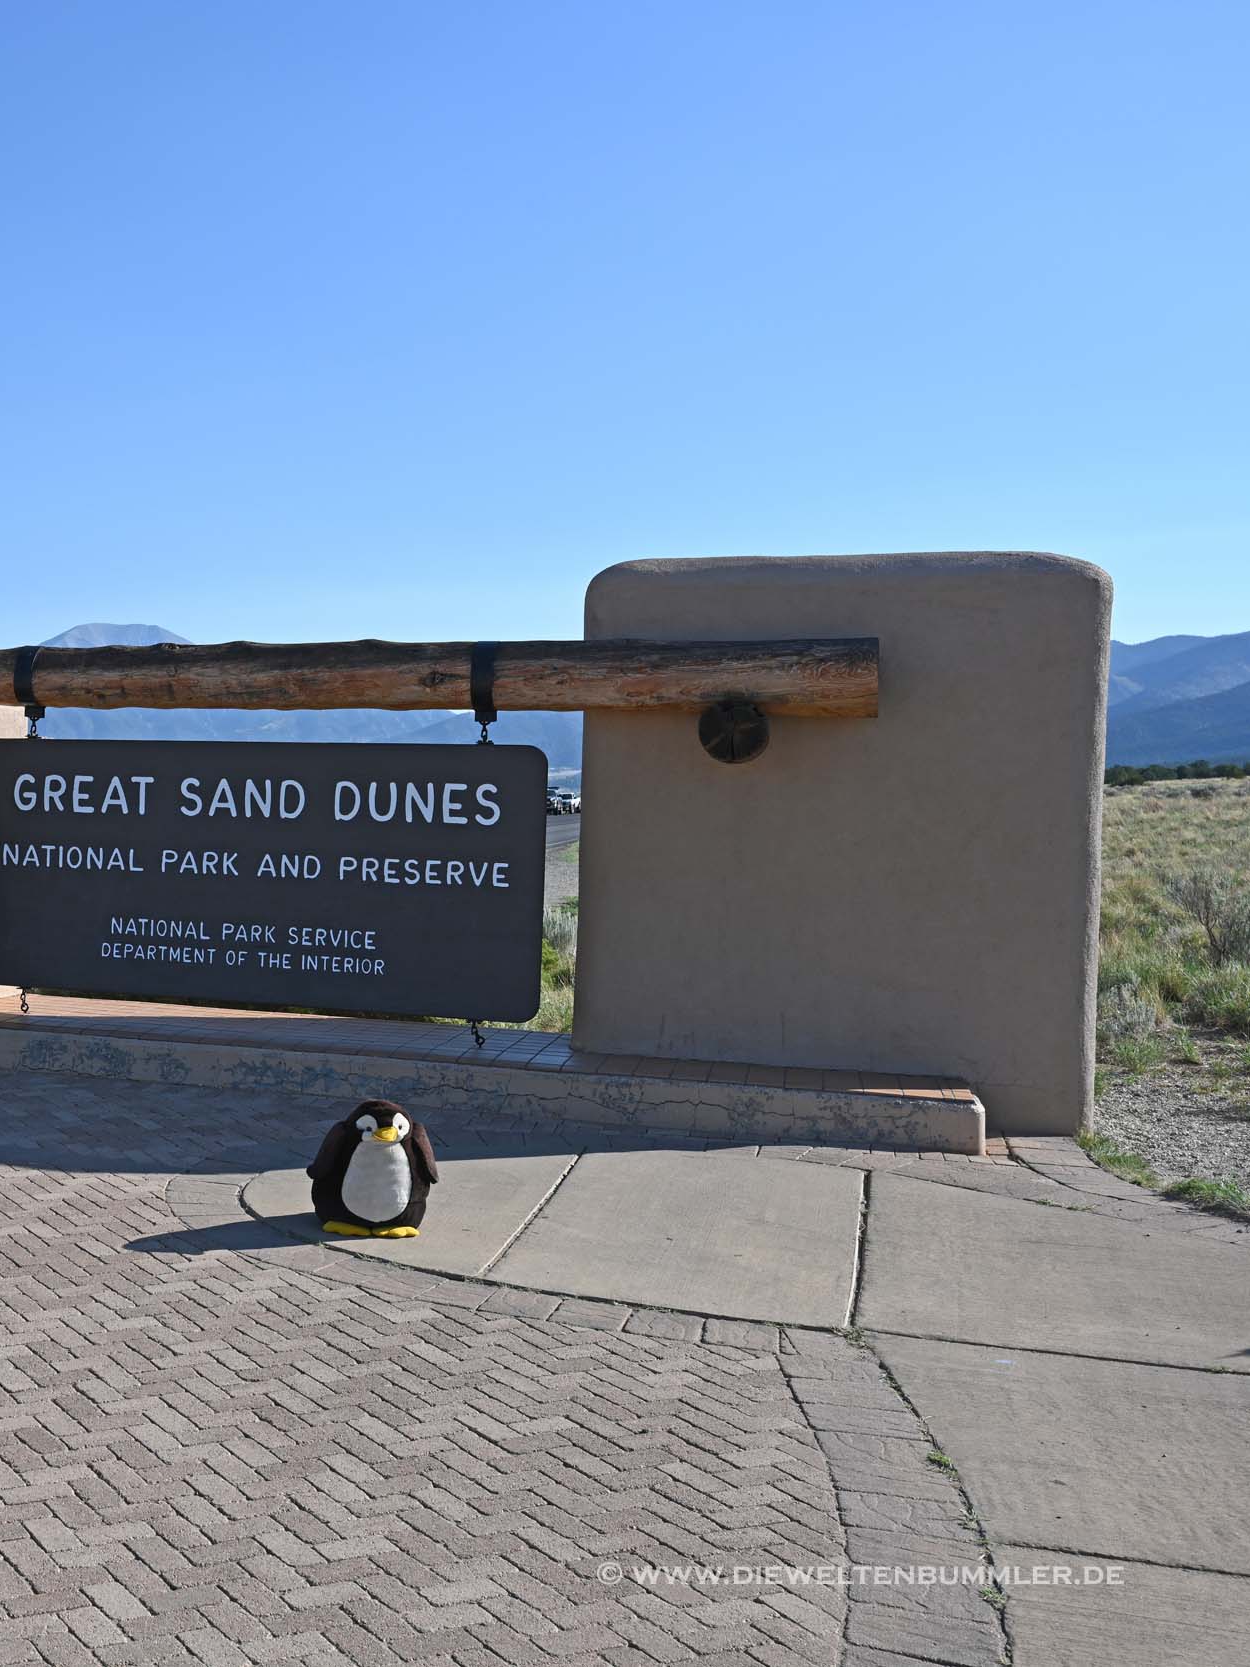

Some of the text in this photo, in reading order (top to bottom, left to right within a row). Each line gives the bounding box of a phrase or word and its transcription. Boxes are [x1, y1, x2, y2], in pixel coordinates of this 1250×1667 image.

[14, 774, 500, 825] GREAT SAND DUNES
[3, 844, 509, 887] NATIONAL PARK AND PRESERVE
[111, 917, 375, 949] NATIONAL PARK SERVICE
[102, 943, 384, 975] DEPARTMENT OF THE INTERIOR
